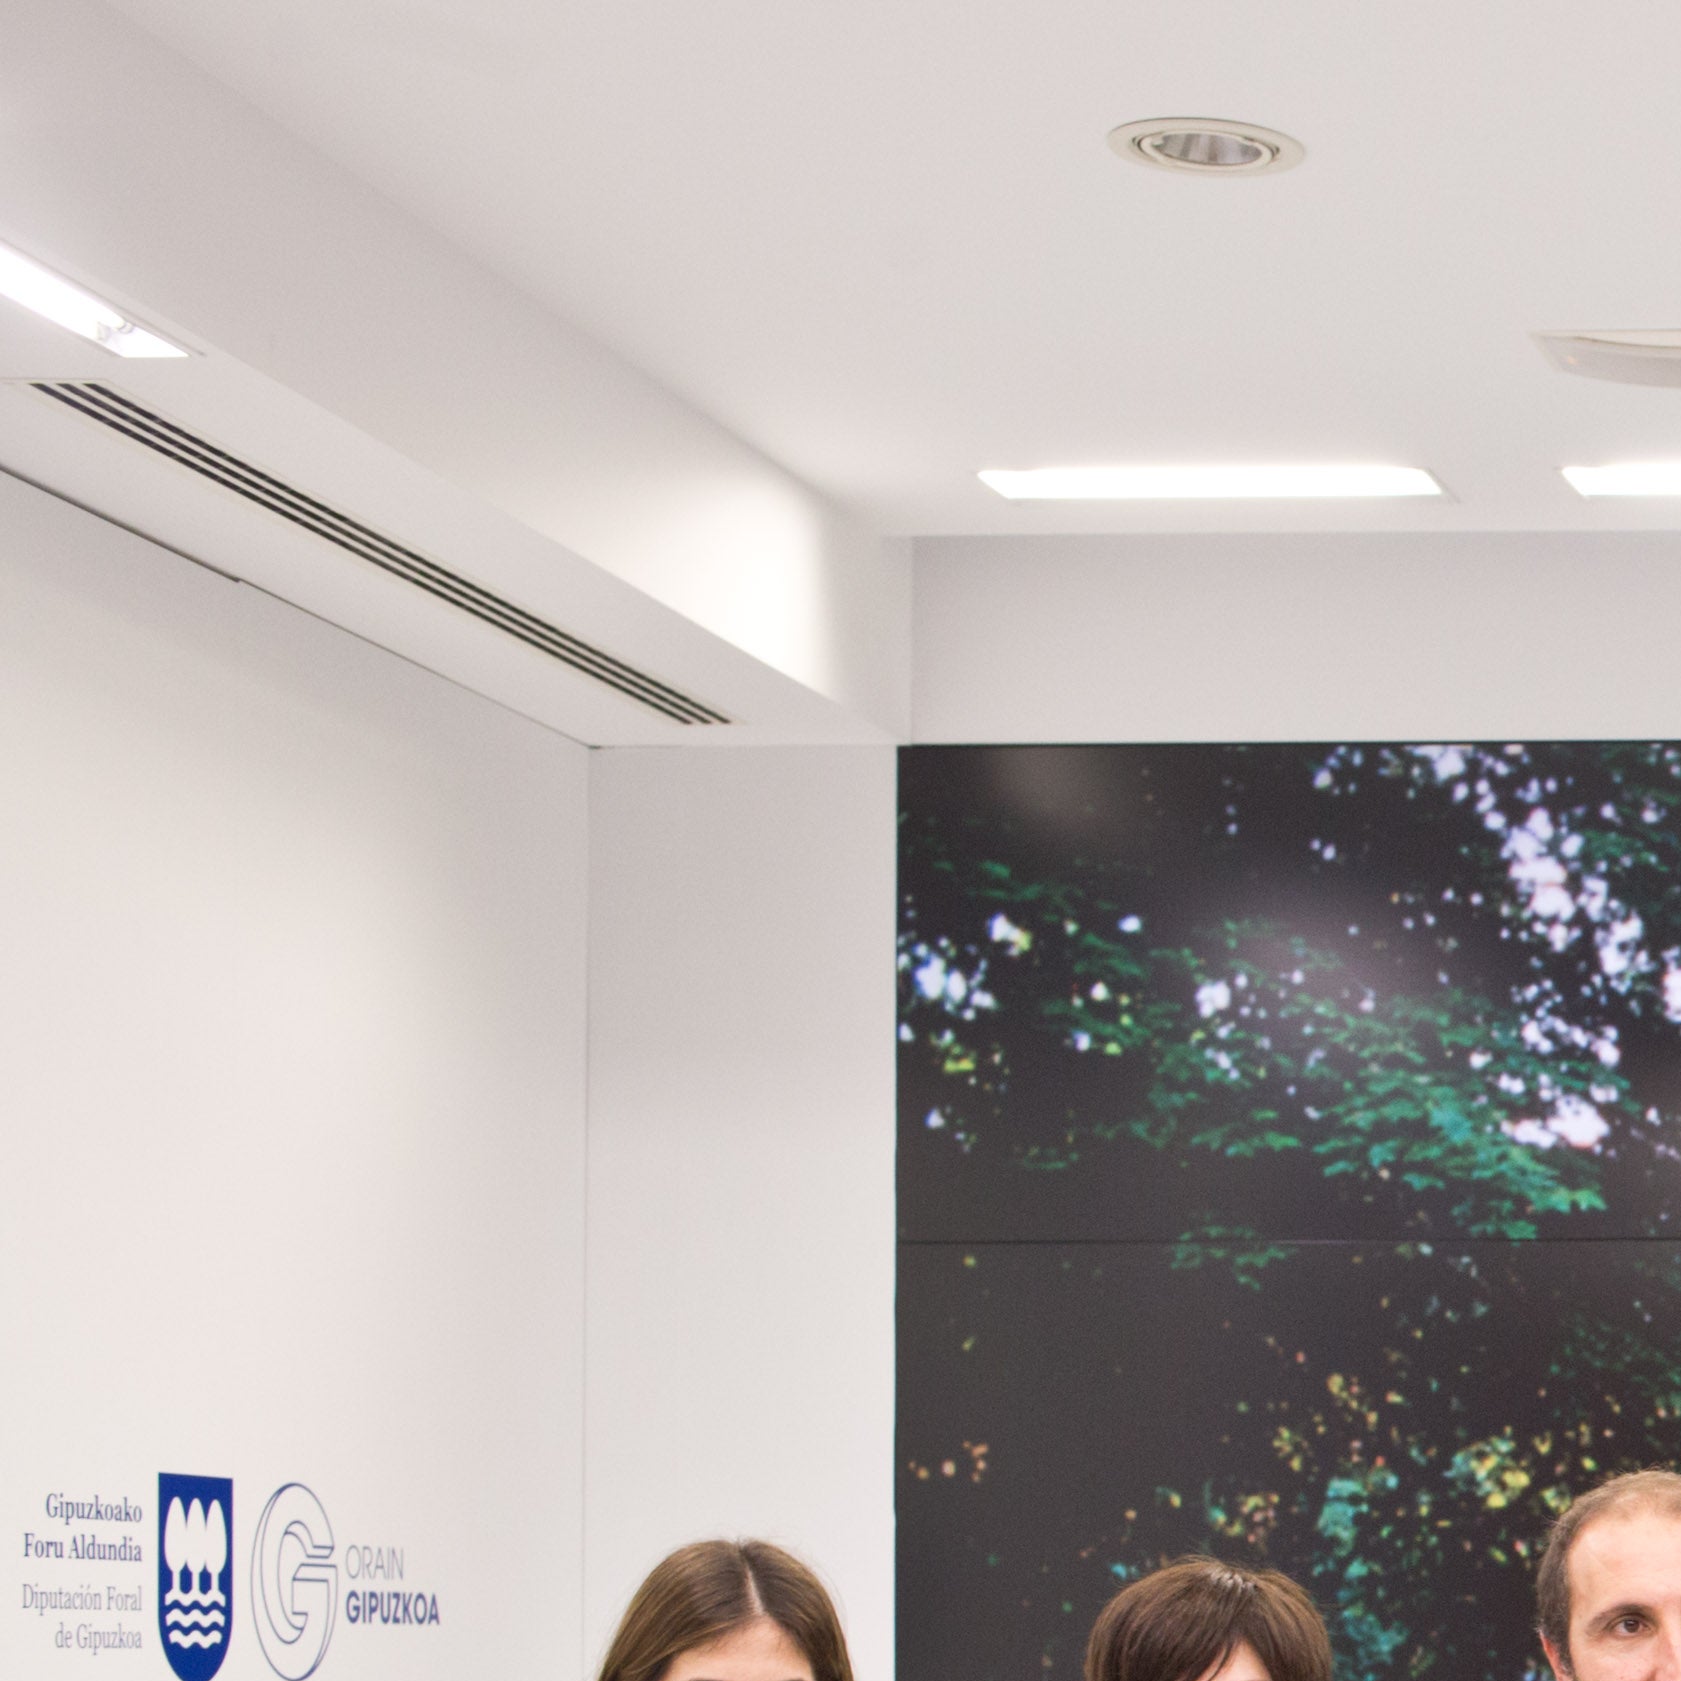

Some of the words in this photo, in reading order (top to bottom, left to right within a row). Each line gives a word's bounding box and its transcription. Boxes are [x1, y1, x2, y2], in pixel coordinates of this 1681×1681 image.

[46, 1493, 142, 1526] Gipuzkoako
[24, 1533, 64, 1559] Foru
[69, 1536, 142, 1562] Aldundia
[345, 1545, 404, 1580] ORAIN
[22, 1584, 102, 1616] Diputación
[107, 1586, 142, 1611] Foral
[345, 1591, 440, 1625] GIPUZKOA
[55, 1627, 73, 1648] de
[77, 1627, 142, 1656] Gipuzkoa
